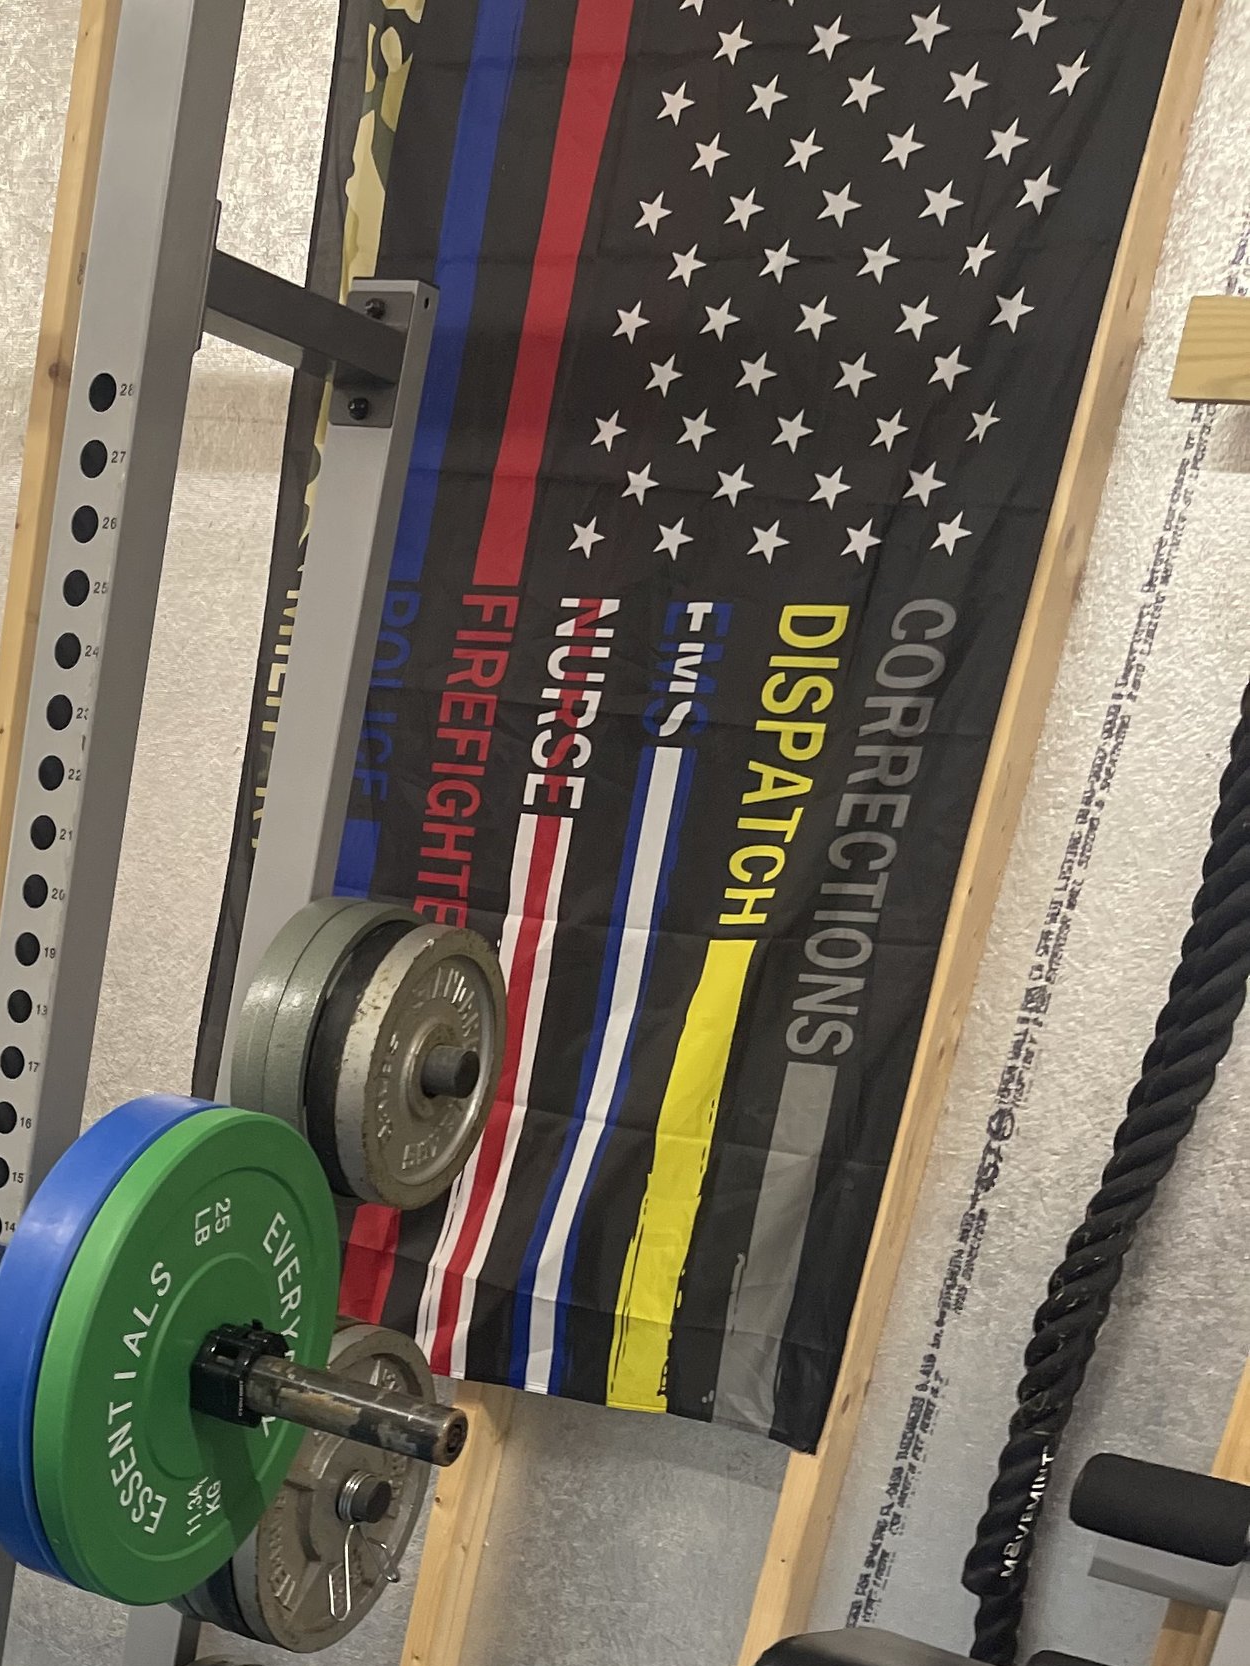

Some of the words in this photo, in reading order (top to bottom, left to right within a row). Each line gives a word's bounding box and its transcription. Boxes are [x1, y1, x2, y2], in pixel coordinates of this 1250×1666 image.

[111, 450, 126, 465] 27
[102, 515, 118, 530] 26
[642, 601, 734, 738] EMS
[523, 597, 621, 809] NURSE
[413, 593, 520, 928] FIREFIGHTE
[718, 604, 850, 925] DISPATCH
[59, 829, 73, 841] 21
[785, 598, 958, 1056] CORRECTIONS
[44, 946, 56, 960] 19
[28, 1060, 41, 1073] 17
[20, 1116, 32, 1129] 16
[12, 1171, 24, 1184] 15
[194, 1206, 212, 1247] LB
[214, 1197, 232, 1235] 25
[107, 1261, 172, 1534] ESSENTIALS
[205, 1479, 222, 1517] KG
